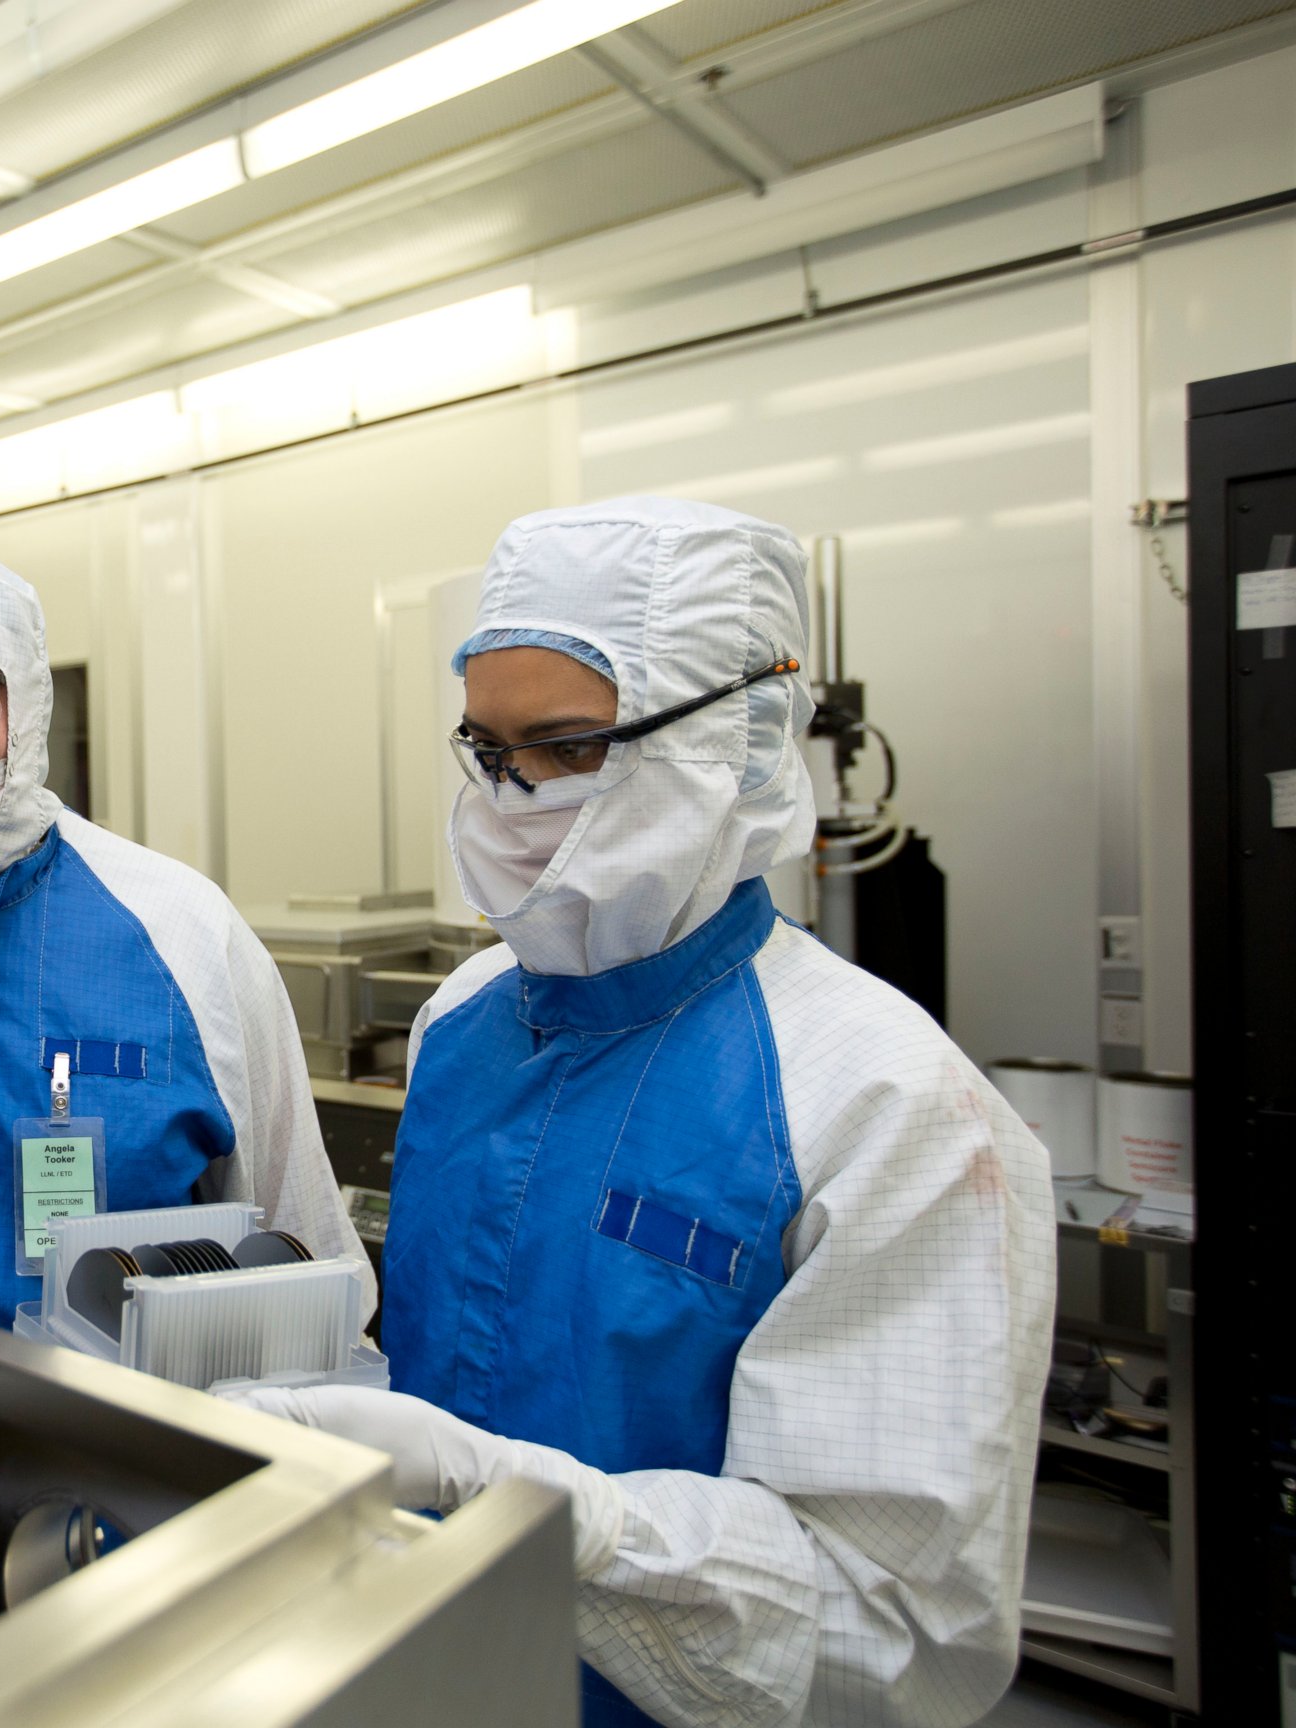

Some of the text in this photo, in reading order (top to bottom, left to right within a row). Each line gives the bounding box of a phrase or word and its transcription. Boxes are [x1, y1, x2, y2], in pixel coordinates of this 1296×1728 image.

[44, 1144, 75, 1154] Angela
[44, 1155, 76, 1164] Tooker
[37, 1198, 84, 1206] RESTRICTIONS
